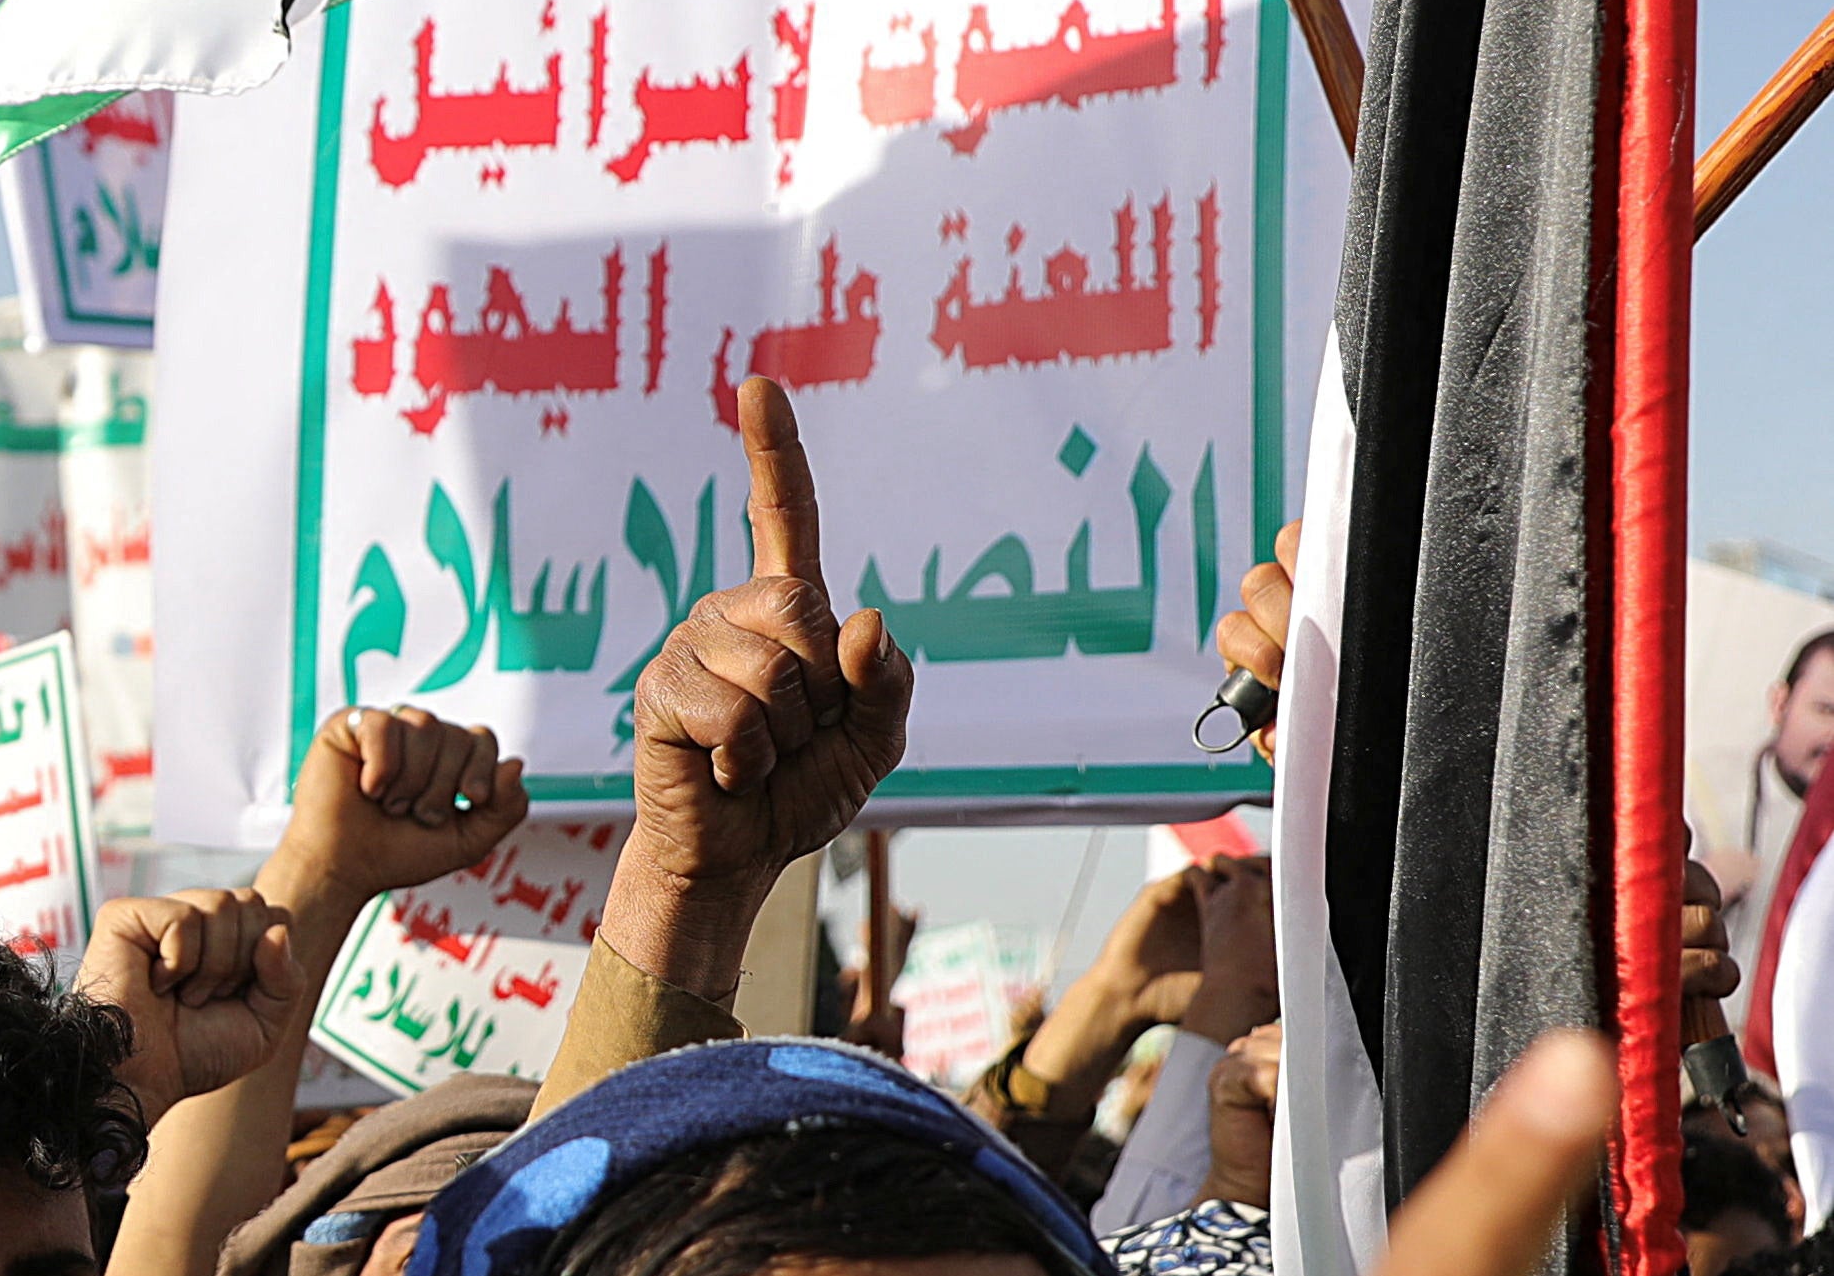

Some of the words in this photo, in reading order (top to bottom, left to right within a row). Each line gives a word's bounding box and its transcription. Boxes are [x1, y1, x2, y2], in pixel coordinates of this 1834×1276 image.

[351, 235, 670, 436] اليهود
[710, 233, 882, 433] على
[930, 178, 1219, 373] اللعنة
[343, 473, 752, 753] لإسلام
[455, 841, 585, 935] لإسرا
[492, 960, 562, 1009] على
[340, 960, 496, 1074] للإسلام
